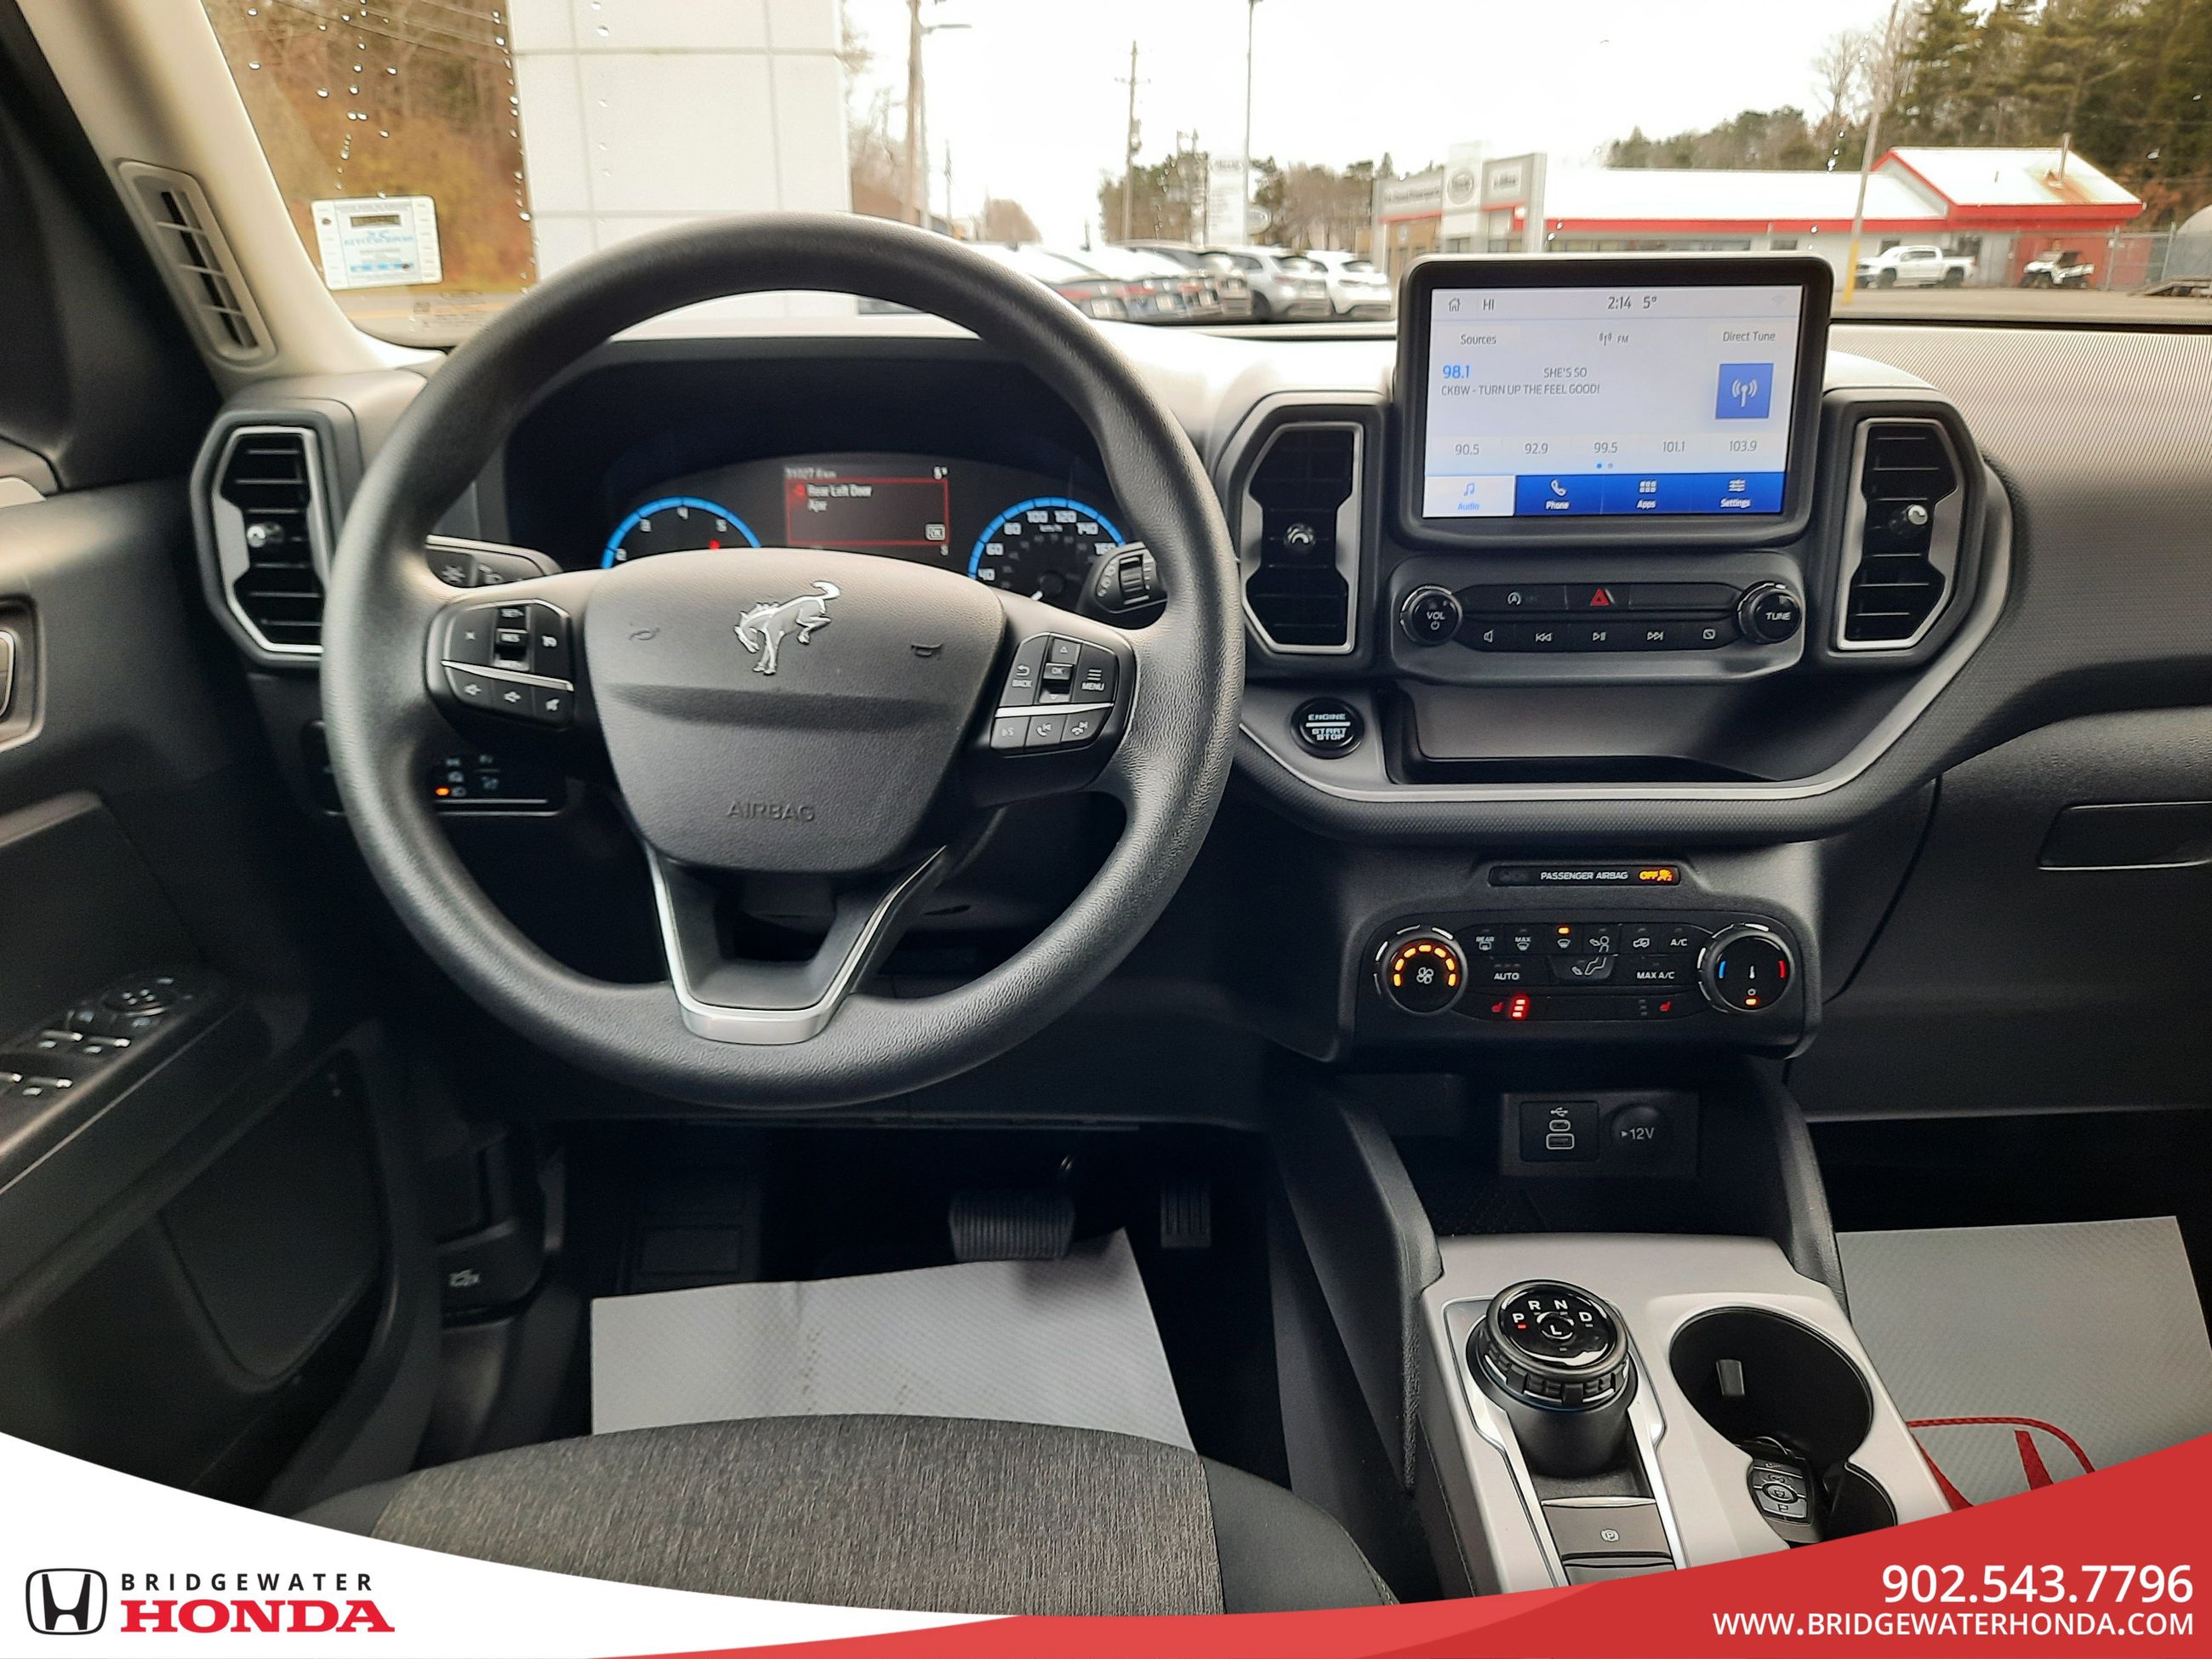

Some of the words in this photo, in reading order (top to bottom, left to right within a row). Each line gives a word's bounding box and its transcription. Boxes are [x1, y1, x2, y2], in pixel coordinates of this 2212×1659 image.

[1482, 299, 1495, 311] HI
[1607, 296, 1632, 310] 2:14
[1460, 334, 1497, 345] Sources
[1616, 335, 1629, 344] FM
[1722, 331, 1750, 342] Direct
[1753, 330, 1776, 342] Tune
[1442, 364, 1471, 379] 98.1
[1543, 367, 1572, 379] SHE'S
[1574, 367, 1588, 378] SO
[1441, 385, 1470, 396] CKBW
[1479, 384, 1505, 396] TURN
[1507, 384, 1520, 396] UP
[1523, 383, 1542, 396] THE
[1544, 383, 1567, 395] FEEL
[1455, 443, 1479, 456] 90.5
[1525, 442, 1548, 455] 92.9
[1593, 442, 1618, 453] 99.5
[1662, 441, 1685, 453] 101.1
[1729, 440, 1757, 452] 103.9
[1457, 502, 1479, 511] Audio
[1546, 500, 1570, 510] Phone
[1637, 500, 1656, 510] Apps
[1720, 498, 1751, 510] Settings
[1427, 611, 1445, 620] VOL
[1765, 612, 1792, 620] TUNE
[1052, 666, 1063, 675] OK
[1081, 682, 1104, 691] MENU
[727, 801, 815, 822] AIRBAG
[1540, 871, 1593, 881] PASSENGER
[1595, 871, 1628, 880] AIRBAG
[1639, 870, 1658, 881] OFF
[1670, 938, 1687, 946] A/C
[1494, 972, 1519, 981] AUTO
[1658, 971, 1674, 979] A/C
[1630, 1127, 1655, 1139] 12V
[1528, 1300, 1541, 1310] R
[1554, 1300, 1568, 1309] N
[1513, 1313, 1525, 1323] P
[1579, 1311, 1593, 1322] D
[1550, 1325, 1562, 1335] L
